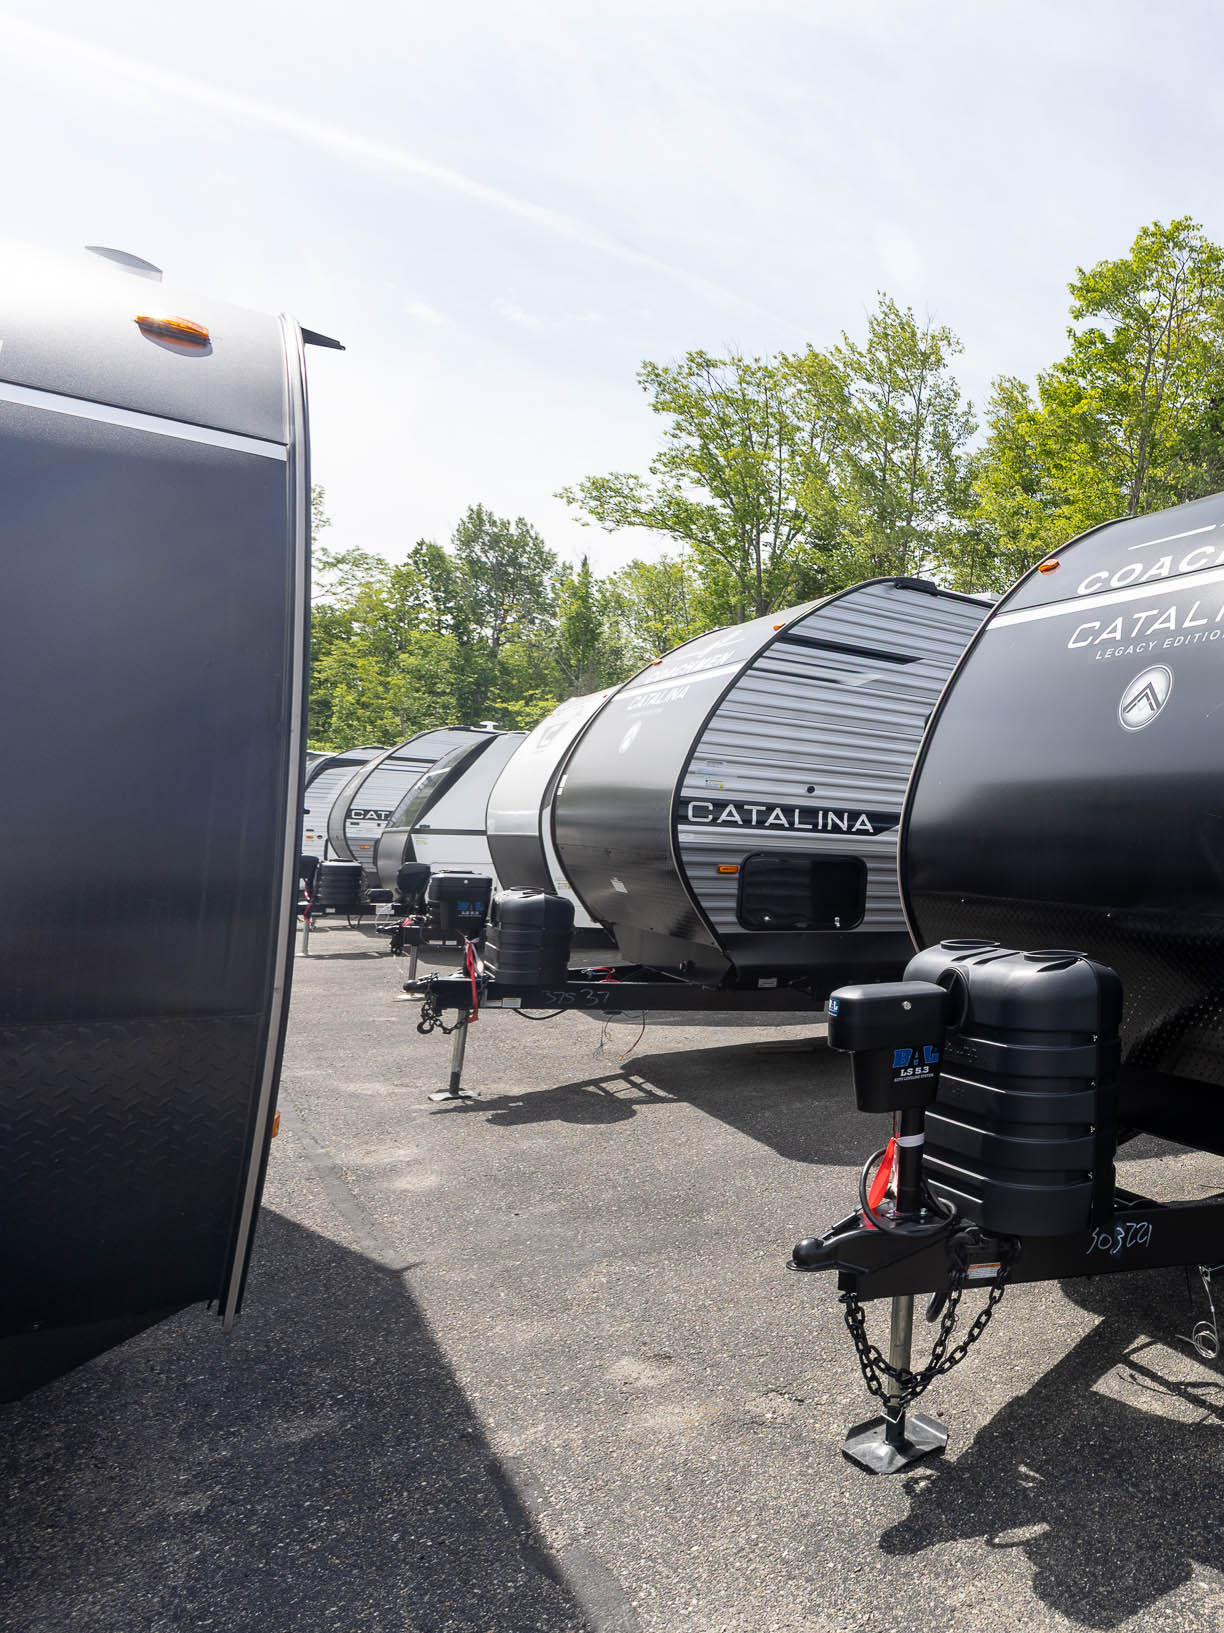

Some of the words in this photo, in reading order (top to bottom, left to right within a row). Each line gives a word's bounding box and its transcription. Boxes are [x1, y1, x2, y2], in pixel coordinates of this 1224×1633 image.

[1095, 640, 1157, 660] LEGACY
[687, 801, 874, 833] CATALINA
[900, 1068, 914, 1077] LS
